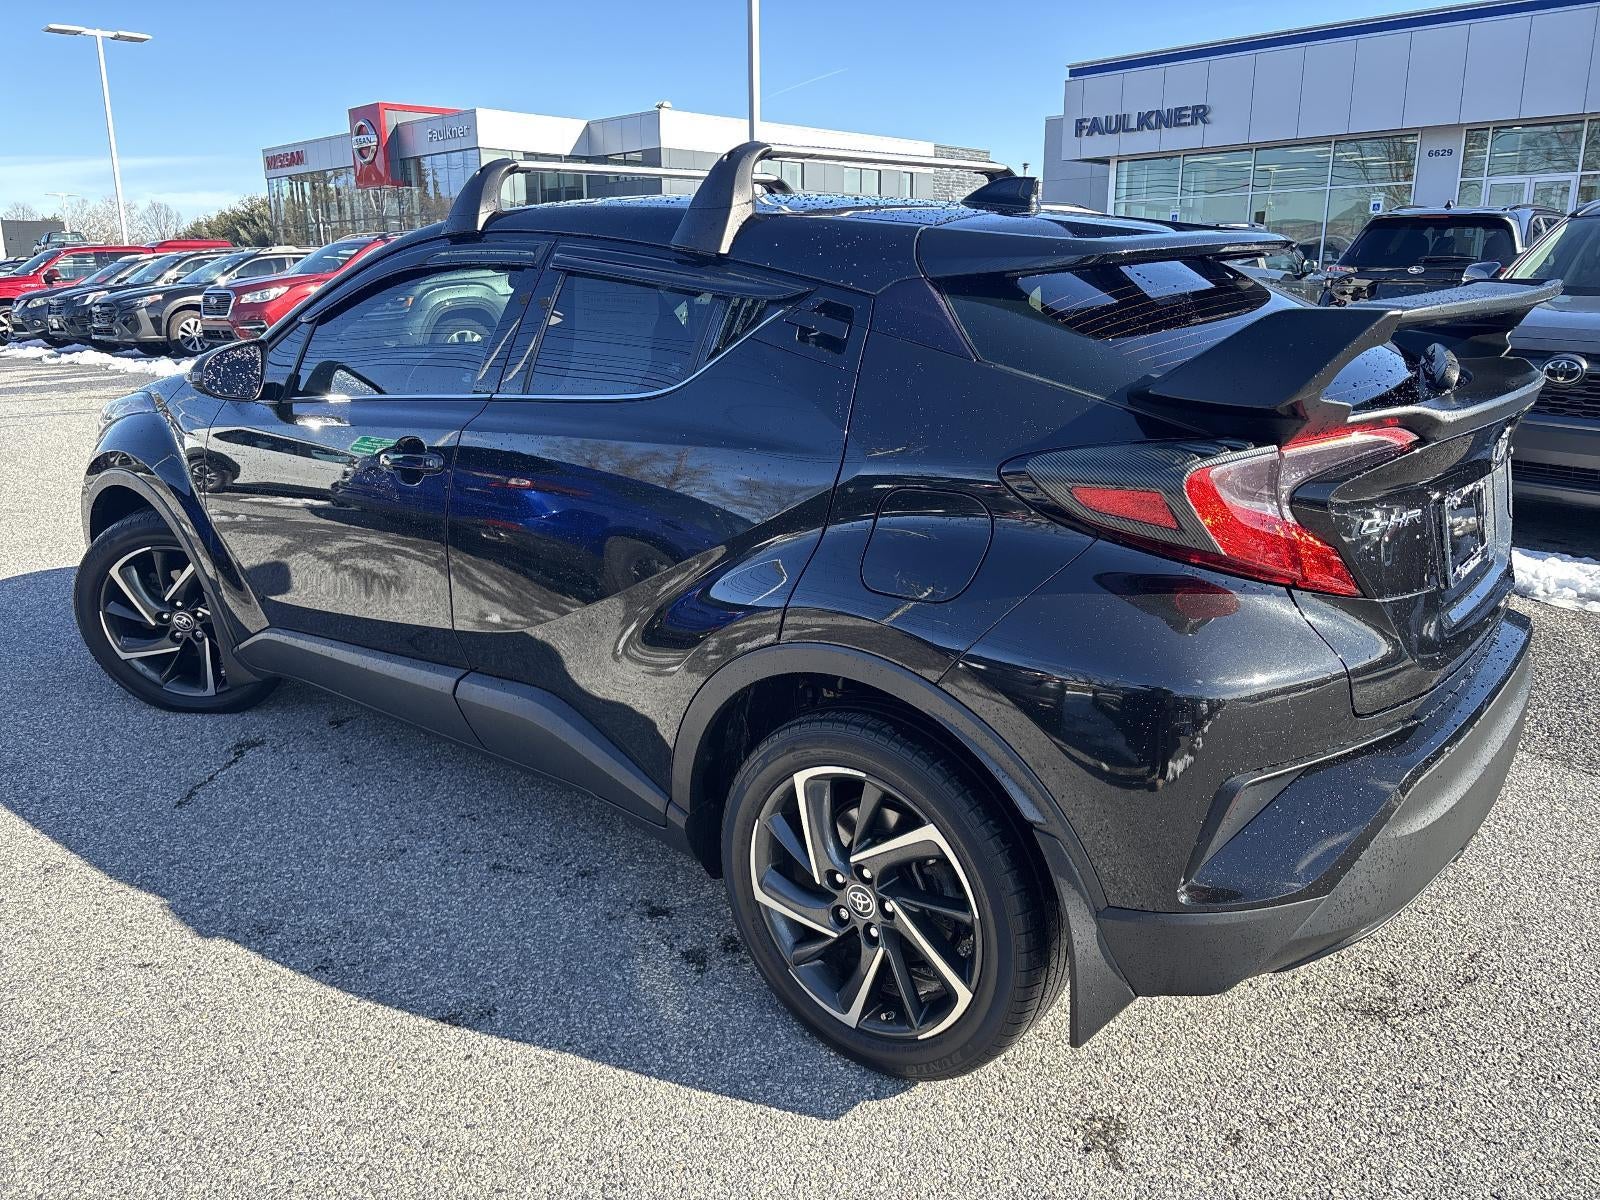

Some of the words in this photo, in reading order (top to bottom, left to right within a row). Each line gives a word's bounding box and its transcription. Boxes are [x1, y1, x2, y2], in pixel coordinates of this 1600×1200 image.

[1075, 104, 1210, 137] FAULKNER
[427, 124, 470, 142] Faulkner
[266, 150, 304, 170] NISSAN
[1427, 148, 1453, 158] 6629
[904, 1053, 961, 1074] DUNLO
